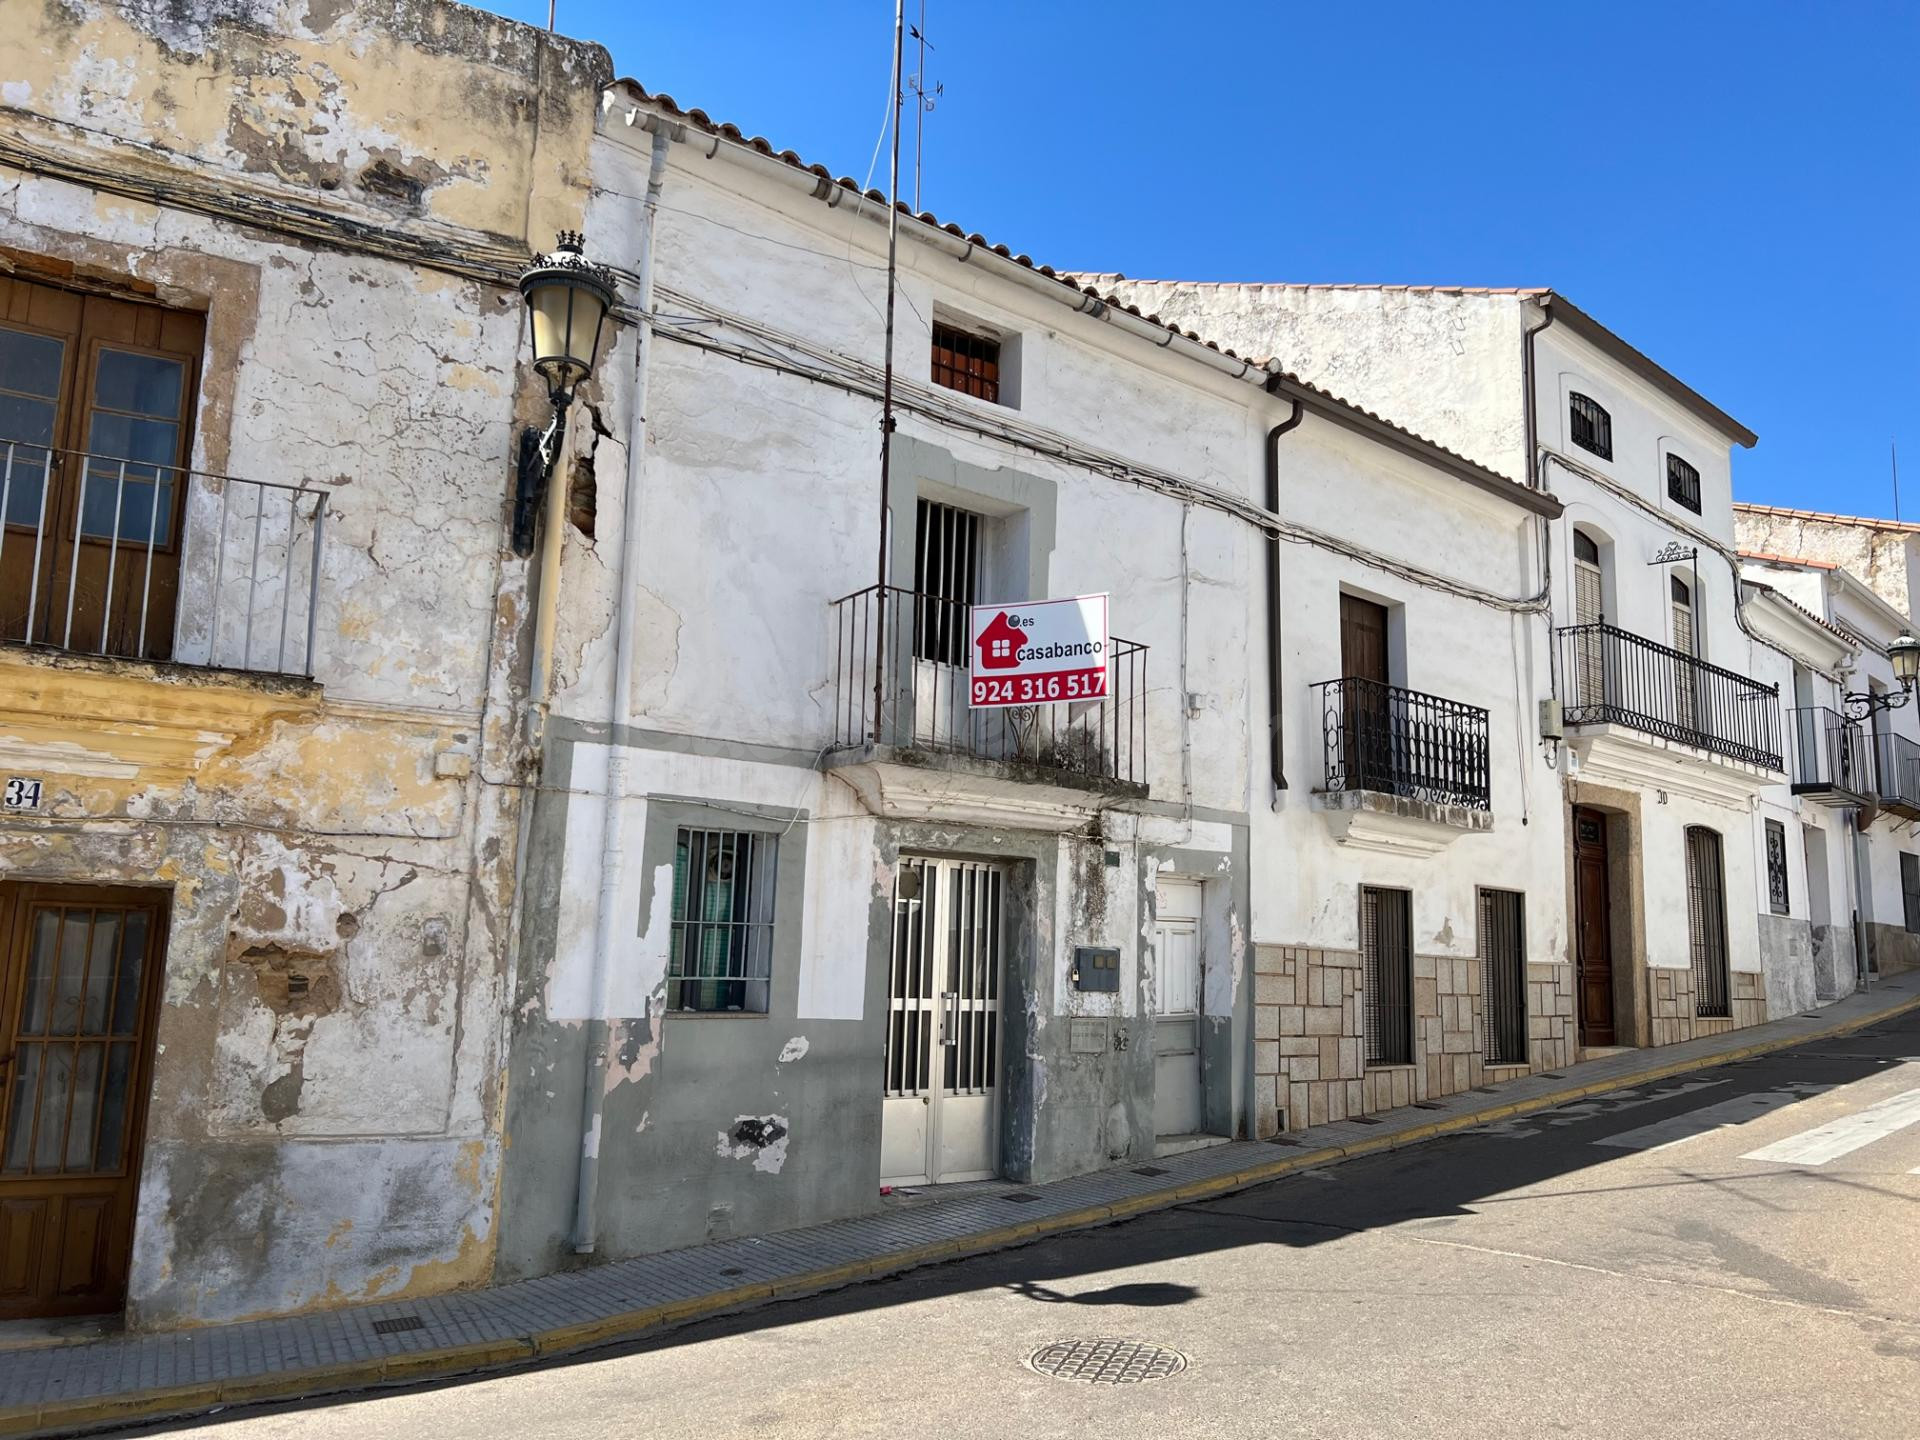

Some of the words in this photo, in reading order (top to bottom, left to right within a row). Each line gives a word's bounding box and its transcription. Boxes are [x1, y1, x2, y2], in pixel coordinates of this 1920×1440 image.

[1017, 641, 1103, 661] casabanco
[974, 681, 1014, 702] 924
[1020, 676, 1060, 700] 316
[1067, 671, 1105, 696] 517
[6, 780, 40, 808] 34
